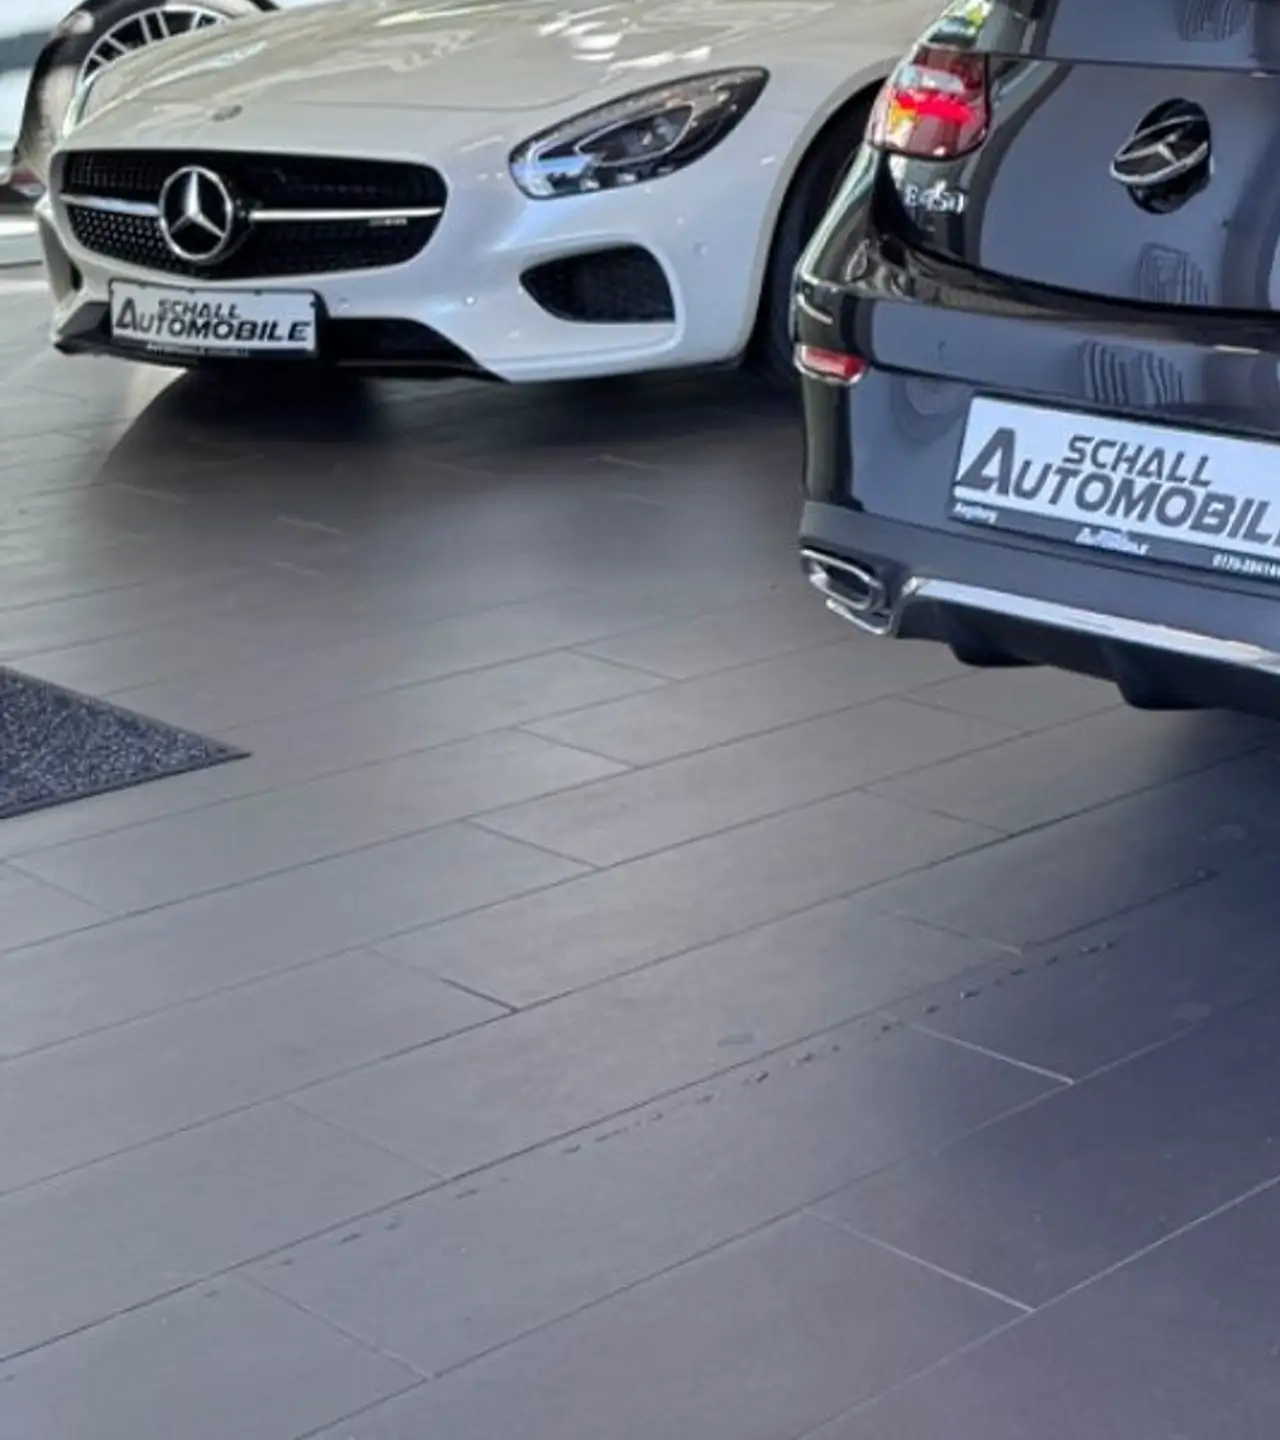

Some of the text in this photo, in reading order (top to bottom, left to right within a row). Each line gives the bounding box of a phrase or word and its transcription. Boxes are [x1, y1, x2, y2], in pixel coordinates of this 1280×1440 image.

[115, 297, 312, 342] AUTOMOBILE
[158, 298, 242, 320] SCHALL
[1063, 433, 1213, 489] SCHALL
